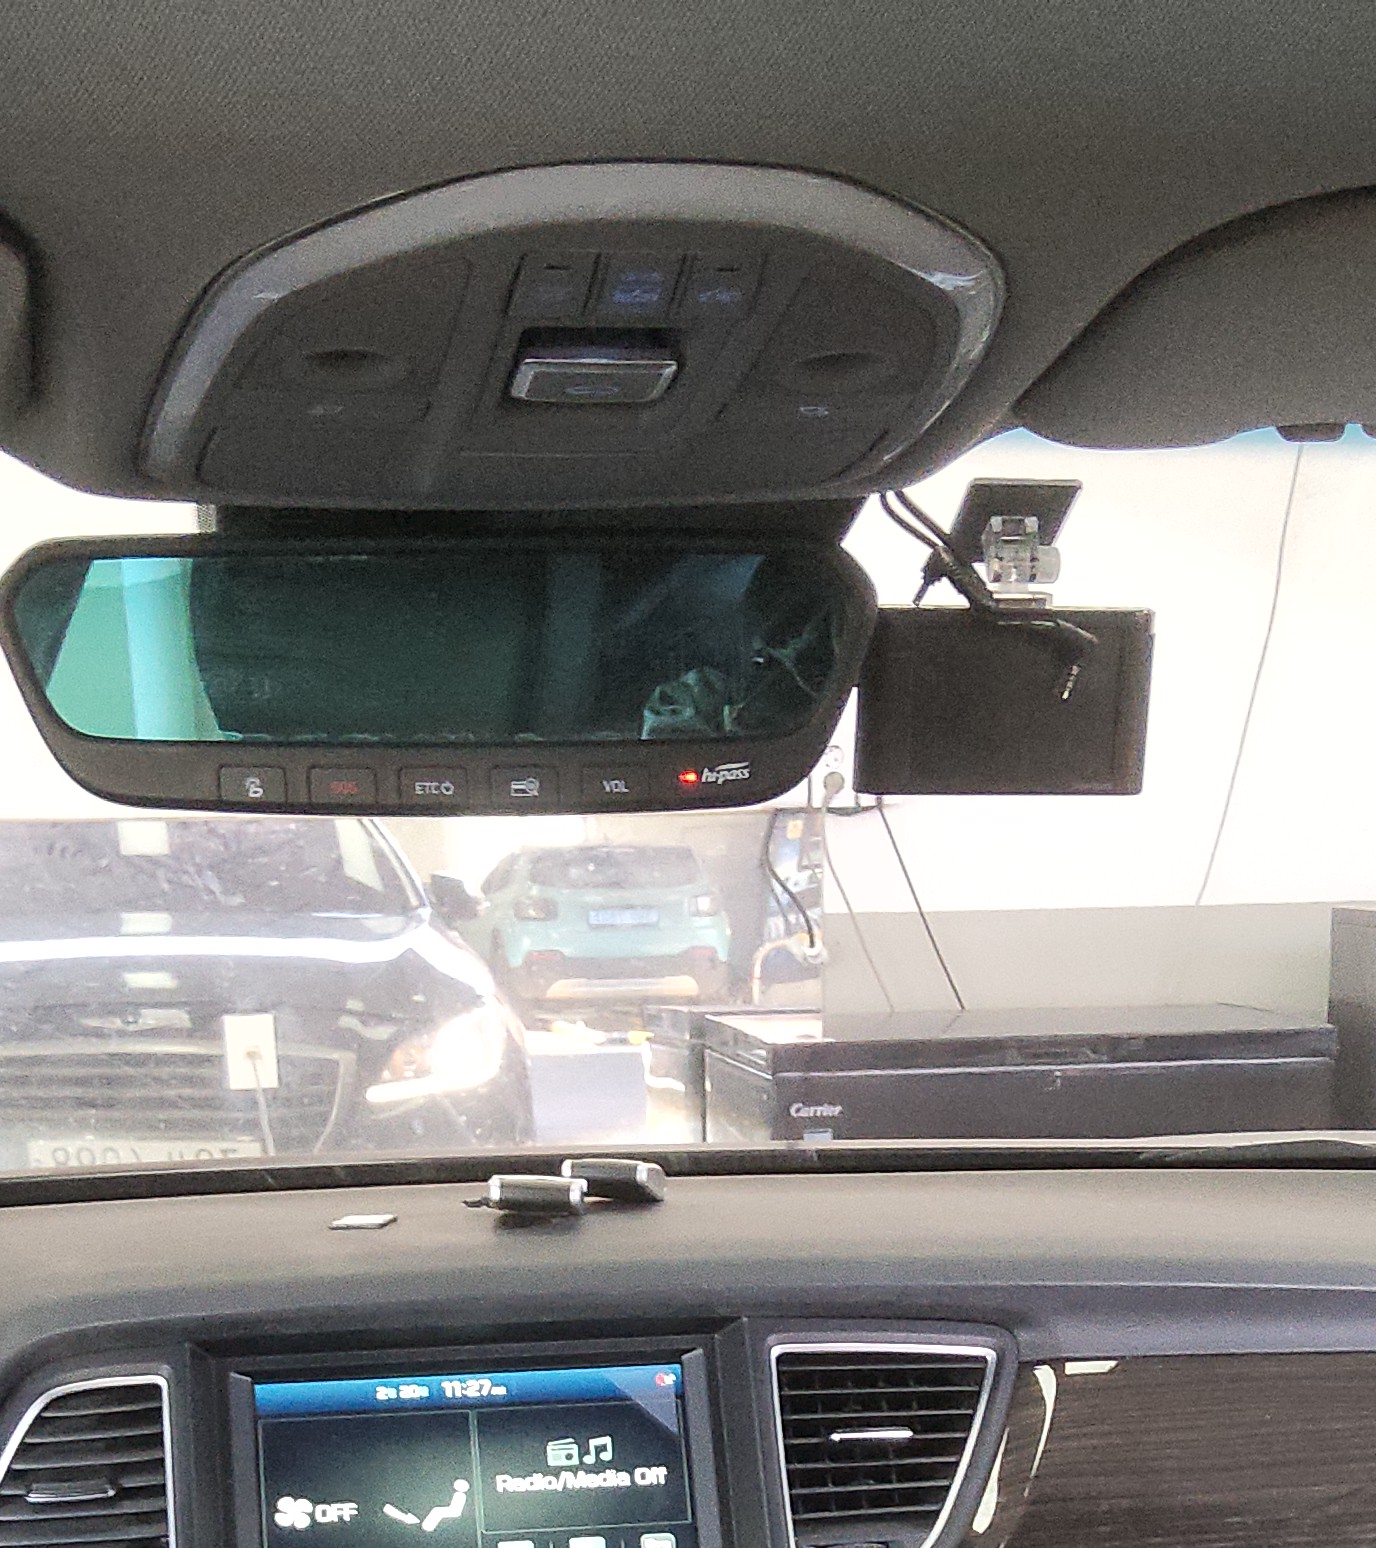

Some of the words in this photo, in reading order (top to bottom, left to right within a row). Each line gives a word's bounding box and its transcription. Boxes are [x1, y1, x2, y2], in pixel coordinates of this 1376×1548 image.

[602, 780, 630, 794] VOL
[789, 1102, 843, 1118] Carrier
[441, 1378, 492, 1398] 11:27
[496, 1468, 631, 1493] Radio/Media
[634, 1465, 667, 1485] Off
[314, 1502, 358, 1523] OFF
